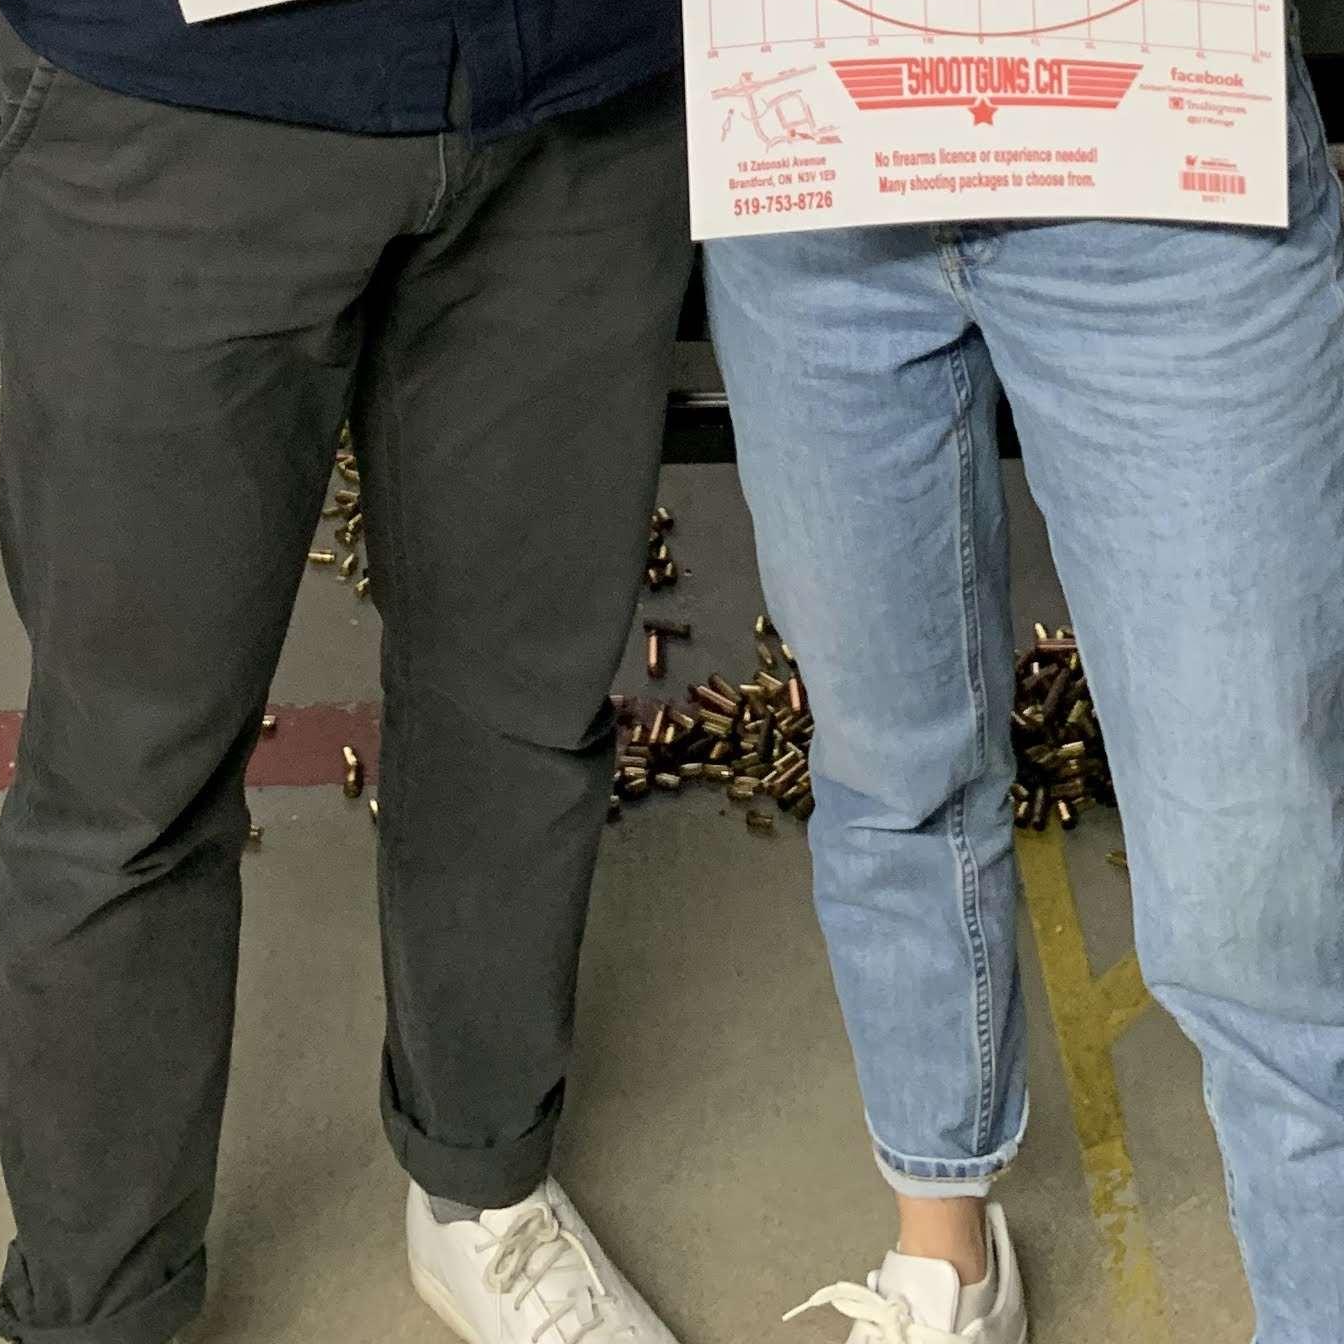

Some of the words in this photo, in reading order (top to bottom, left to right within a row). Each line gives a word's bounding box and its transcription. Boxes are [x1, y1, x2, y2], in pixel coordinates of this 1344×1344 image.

[907, 57, 1063, 95] SHOOTGUNS.CA
[1170, 67, 1244, 87] facebook
[874, 151, 890, 167] No
[892, 150, 936, 166] firearms
[939, 148, 977, 164] licence
[979, 150, 991, 162] or
[994, 147, 1052, 165] experience
[1055, 147, 1098, 163] needed!
[778, 174, 792, 185] ON
[879, 176, 906, 195] Many
[909, 174, 956, 193] shooting
[959, 172, 1009, 190] packages
[1011, 173, 1023, 187] to
[1025, 172, 1065, 187] choose
[734, 190, 833, 216] 519-753-8726
